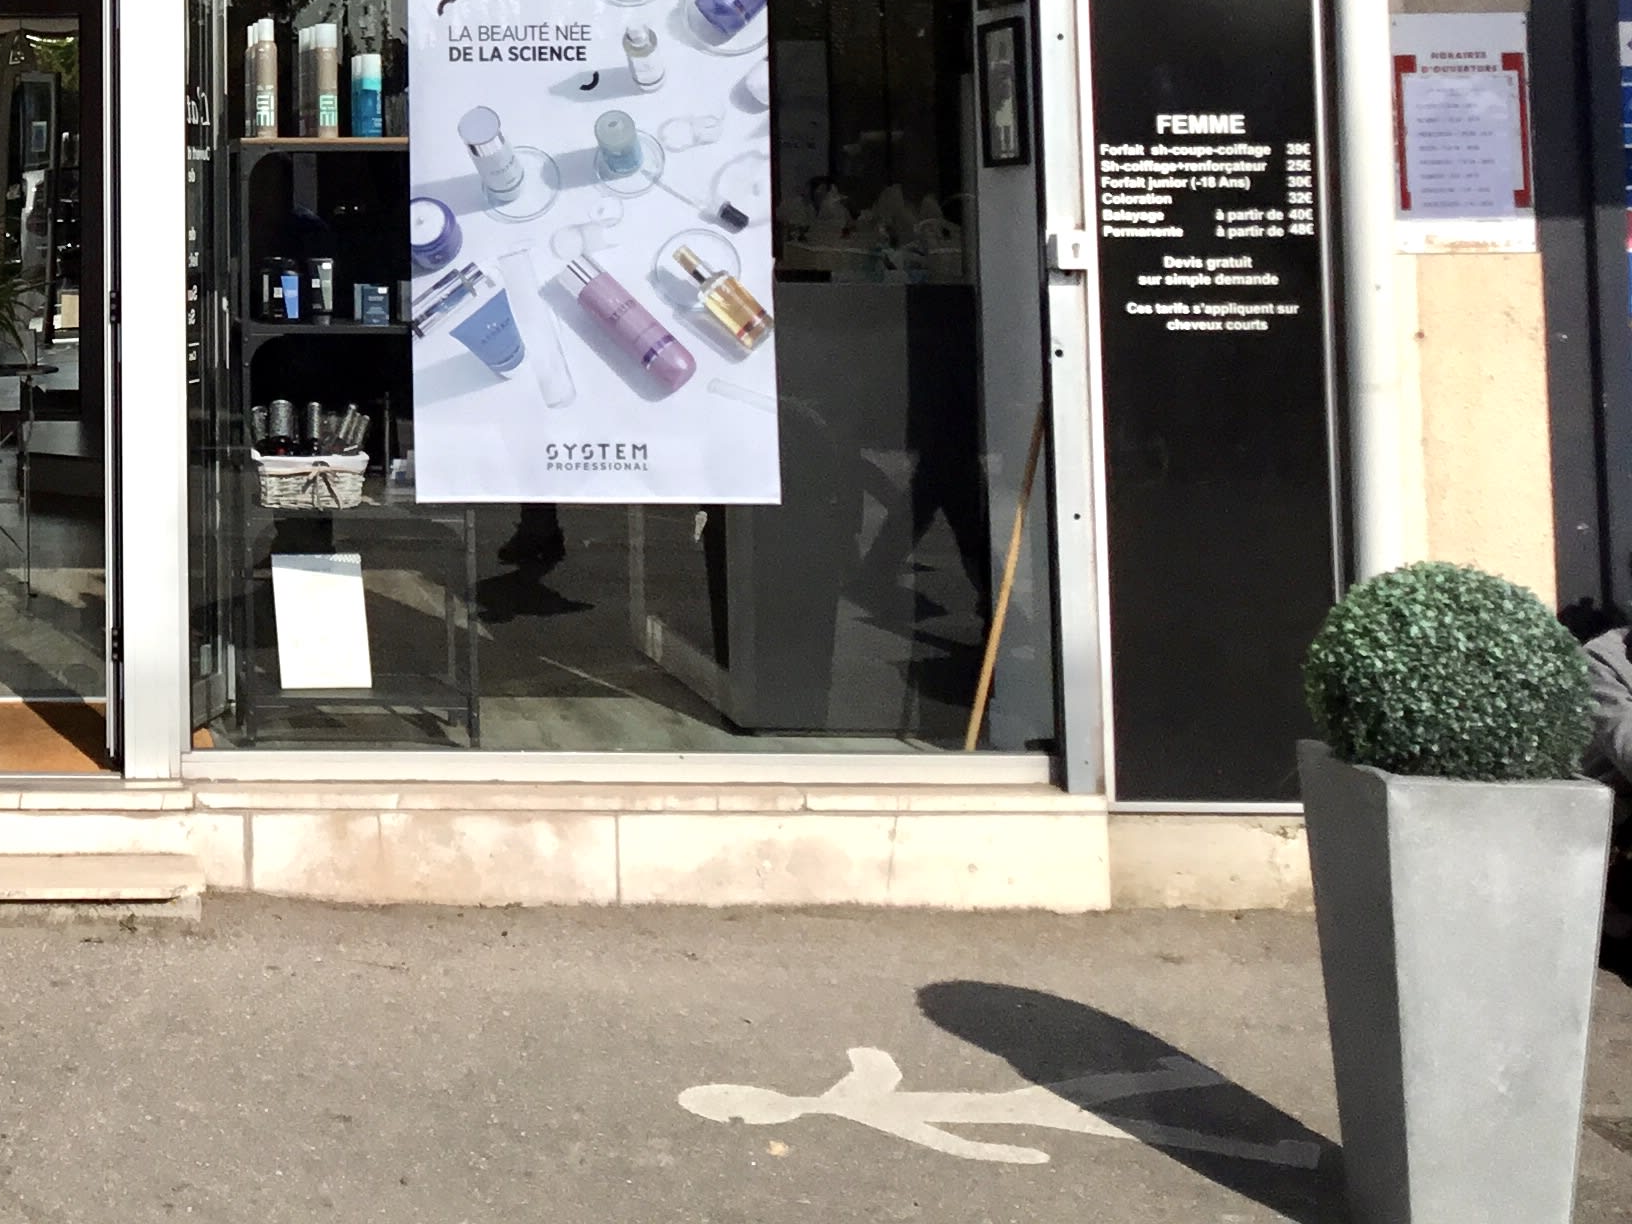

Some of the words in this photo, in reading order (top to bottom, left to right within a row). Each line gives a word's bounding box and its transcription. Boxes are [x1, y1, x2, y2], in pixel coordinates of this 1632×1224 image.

[449, 26, 472, 41] LA
[478, 23, 549, 41] BEAUTÉ
[556, 22, 591, 41] NÉE
[449, 47, 473, 61] DE
[479, 47, 503, 61] LA
[508, 46, 587, 61] SCIENCE
[1157, 115, 1246, 134] FEMME
[1100, 144, 1144, 155] Forfait
[1287, 160, 1311, 171] 25€
[1101, 177, 1145, 188] Forfait
[1148, 177, 1188, 190] junior
[1219, 177, 1251, 190] Ans)
[1288, 176, 1312, 187] 30€
[1102, 193, 1172, 204] Coloration
[1288, 192, 1313, 204] 32€
[1102, 209, 1164, 223] Balayage
[1216, 210, 1224, 220] à
[1227, 209, 1264, 223] partir
[1267, 209, 1283, 220] de
[1288, 209, 1313, 220] 40€
[1103, 226, 1183, 237] Permanente
[1216, 226, 1224, 237] à
[1228, 226, 1264, 239] partir
[1267, 226, 1284, 237] de
[1163, 256, 1203, 268] Devis
[1206, 256, 1252, 270] gratuit
[1138, 276, 1162, 285] sur
[1165, 273, 1211, 287] simple
[1215, 274, 1279, 285] demande
[1126, 302, 1152, 314] Ces
[1155, 302, 1190, 314] tarifs
[1192, 303, 1274, 316] s'appliquent
[1277, 305, 1299, 314] sur
[1167, 320, 1223, 330] cheveux
[1226, 320, 1268, 330] courts
[546, 443, 648, 460] SYSTEM
[547, 462, 648, 471] PROFESSIONAL
